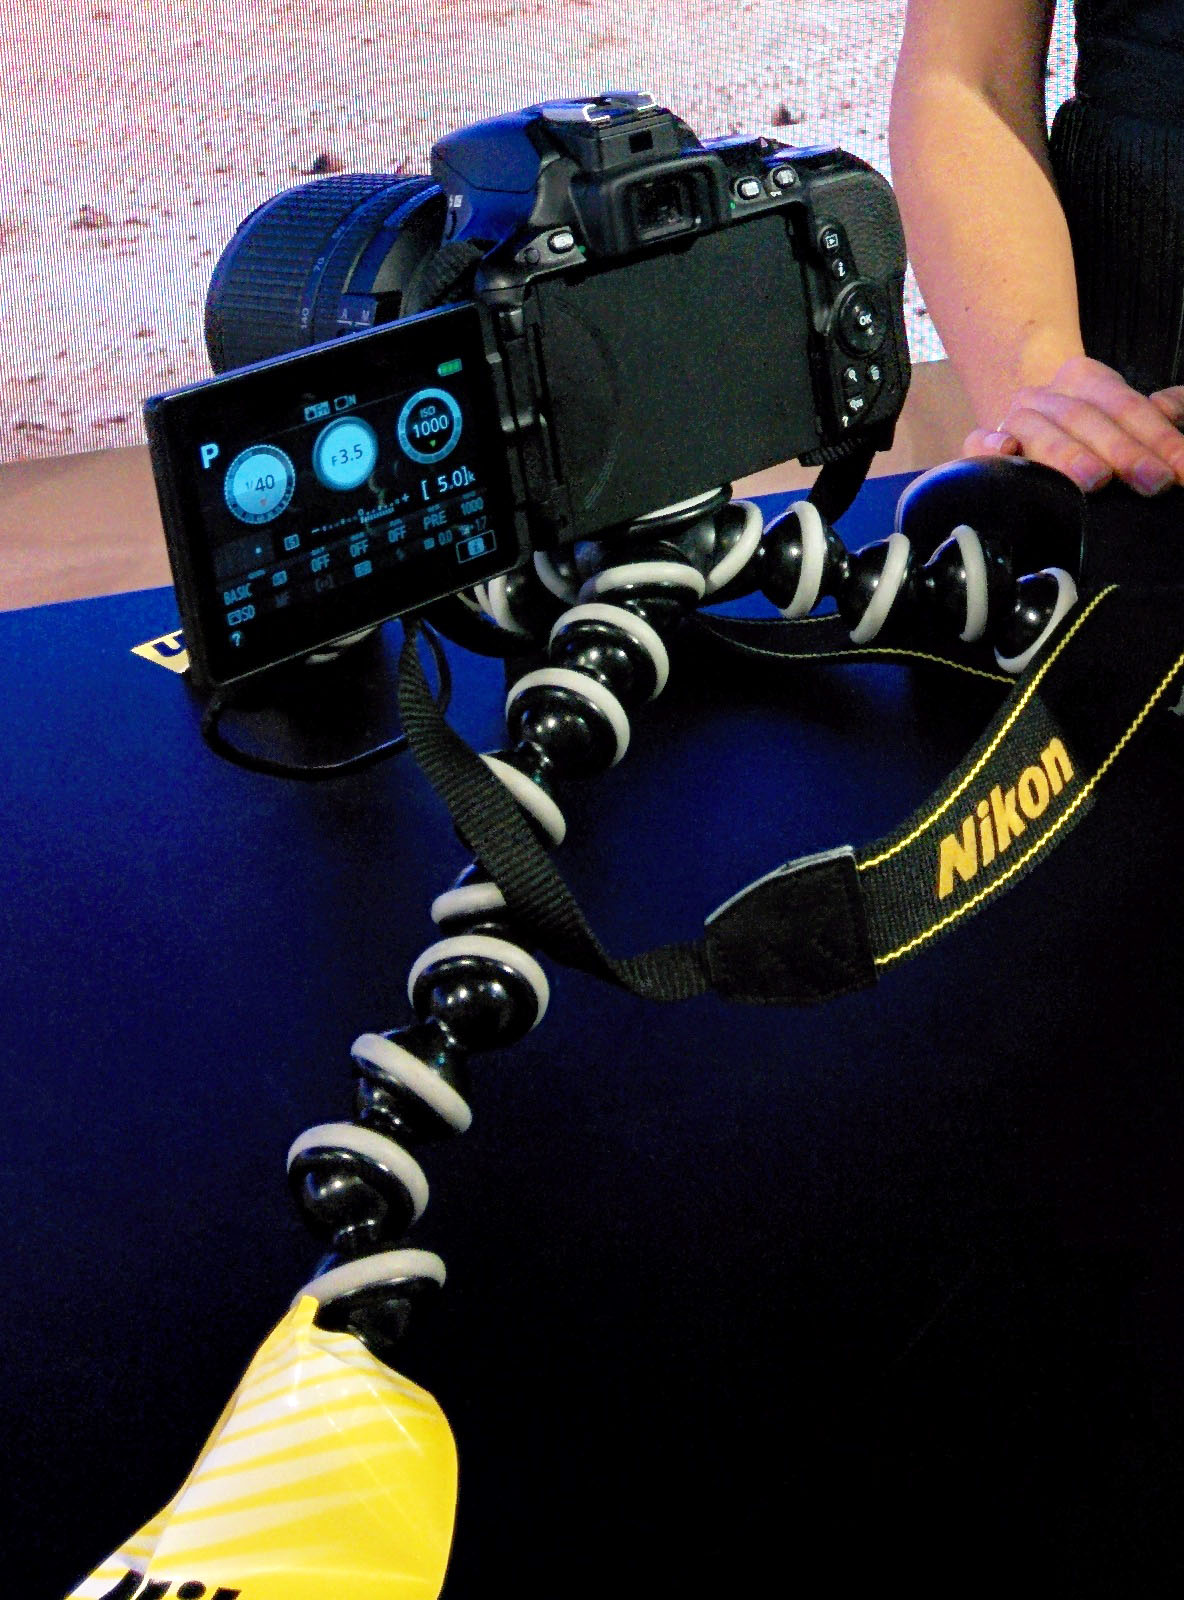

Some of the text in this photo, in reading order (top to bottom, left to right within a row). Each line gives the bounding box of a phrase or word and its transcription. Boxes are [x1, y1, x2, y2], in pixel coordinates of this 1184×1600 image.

[859, 313, 873, 326] OK
[420, 405, 436, 418] ISO
[412, 414, 449, 439] 1000
[200, 443, 220, 469] P
[423, 510, 449, 531] PRE
[936, 736, 1075, 900] Nikon
